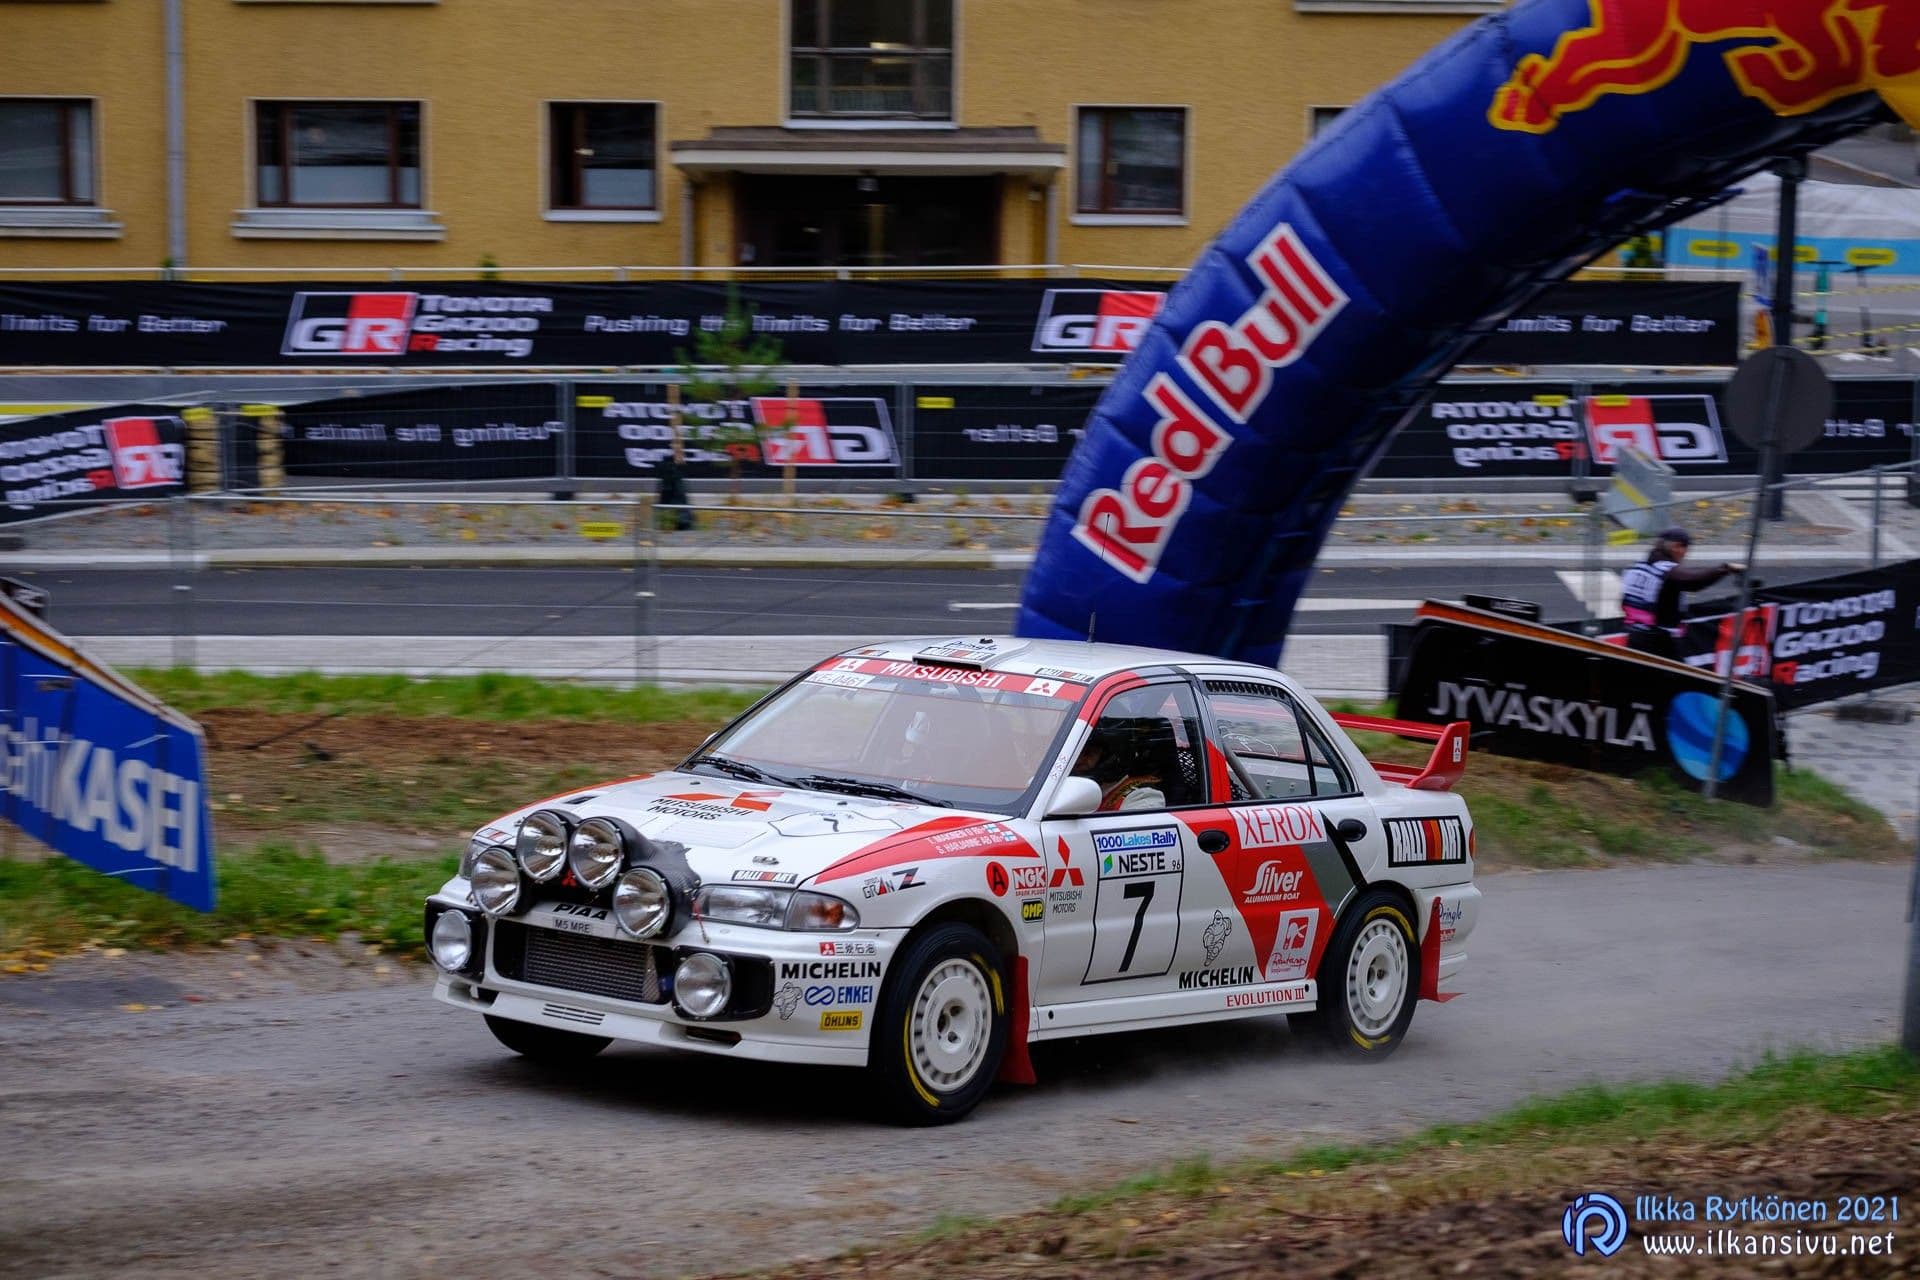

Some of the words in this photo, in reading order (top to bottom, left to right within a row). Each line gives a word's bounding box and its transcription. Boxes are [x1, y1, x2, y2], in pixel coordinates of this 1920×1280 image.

[417, 294, 553, 312] TOYOTA
[138, 315, 228, 332] Better
[289, 317, 407, 350] GR
[412, 314, 539, 332] GAZOO
[584, 315, 690, 336] Pushing
[752, 315, 830, 332] limits
[839, 314, 882, 331] for
[889, 313, 977, 331] Better
[1040, 314, 1153, 349] GR
[1582, 315, 1623, 332] for
[1630, 315, 1715, 332] Better
[410, 333, 534, 357] Racing
[1070, 371, 1234, 584] Red
[1176, 222, 1351, 424] Bull
[1774, 590, 1896, 628] TOYOTA
[1774, 620, 1885, 658] GAZOO
[879, 661, 1007, 688] MITSUBISHI
[1772, 651, 1880, 685] Racing
[647, 806, 723, 821] MOTORS
[1238, 806, 1322, 845] XEROX
[1118, 852, 1165, 873] NESTE
[1172, 860, 1181, 870] 96
[1013, 868, 1046, 889] NGK
[1243, 860, 1303, 895] Silver
[1049, 891, 1082, 902] MITSUBISHI
[553, 904, 608, 920] PIAA
[1052, 903, 1076, 913] MOTORS
[554, 918, 569, 930] M5
[572, 921, 591, 934] MRE
[1119, 881, 1155, 972] 7
[781, 962, 881, 979] MICHELIN
[1179, 966, 1254, 989] MICHELIN
[838, 986, 873, 1003] ENKEI
[1226, 989, 1292, 1007] EVOLUTION
[1295, 987, 1305, 999] III
